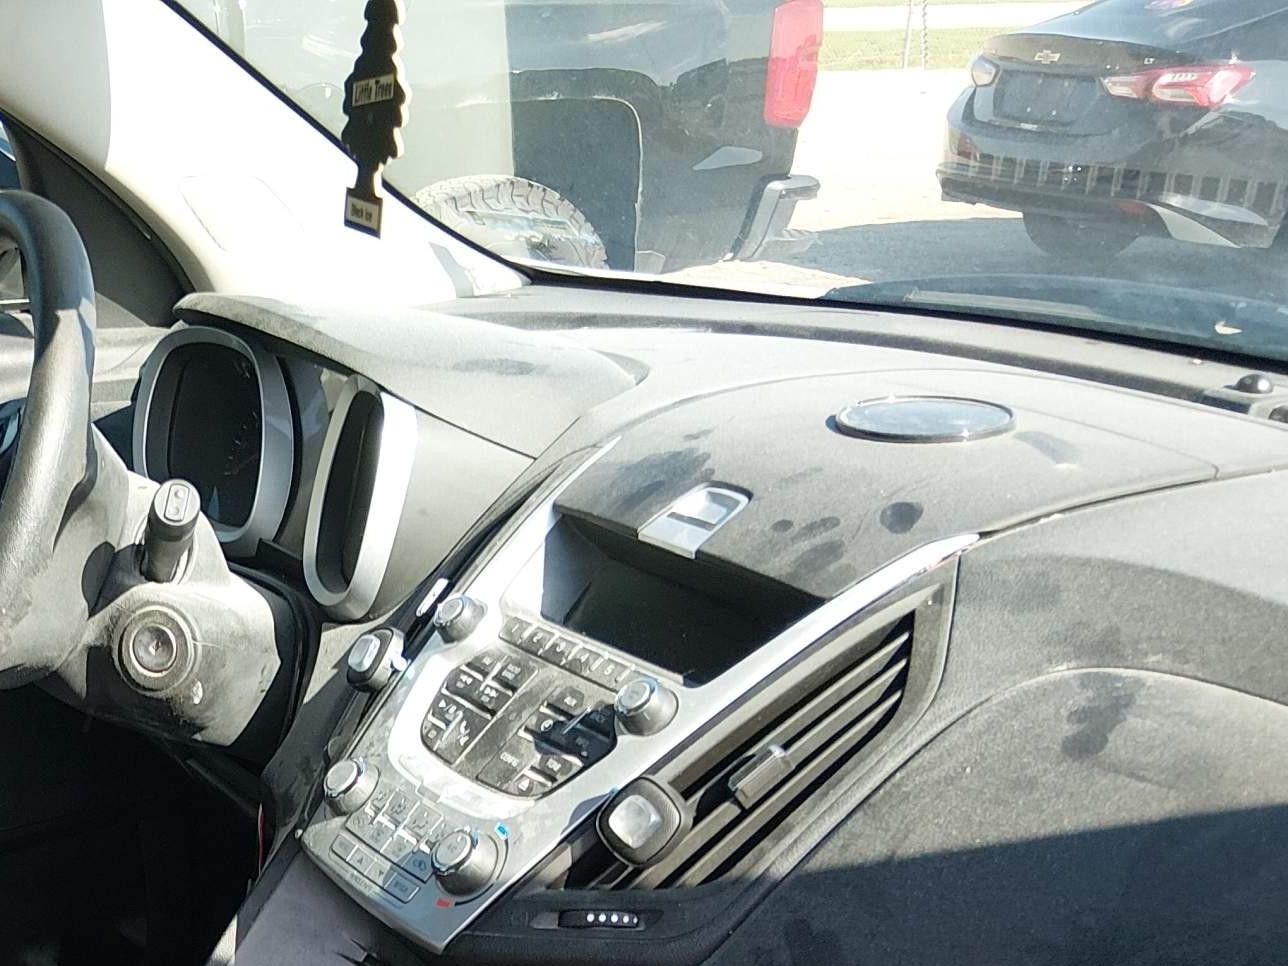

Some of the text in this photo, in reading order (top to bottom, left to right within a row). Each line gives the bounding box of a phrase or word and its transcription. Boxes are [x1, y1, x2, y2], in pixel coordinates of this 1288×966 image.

[354, 79, 393, 103] Little Trees
[532, 631, 544, 643] 2
[555, 640, 567, 653] 3
[580, 652, 590, 663] 4
[603, 664, 615, 676] 5
